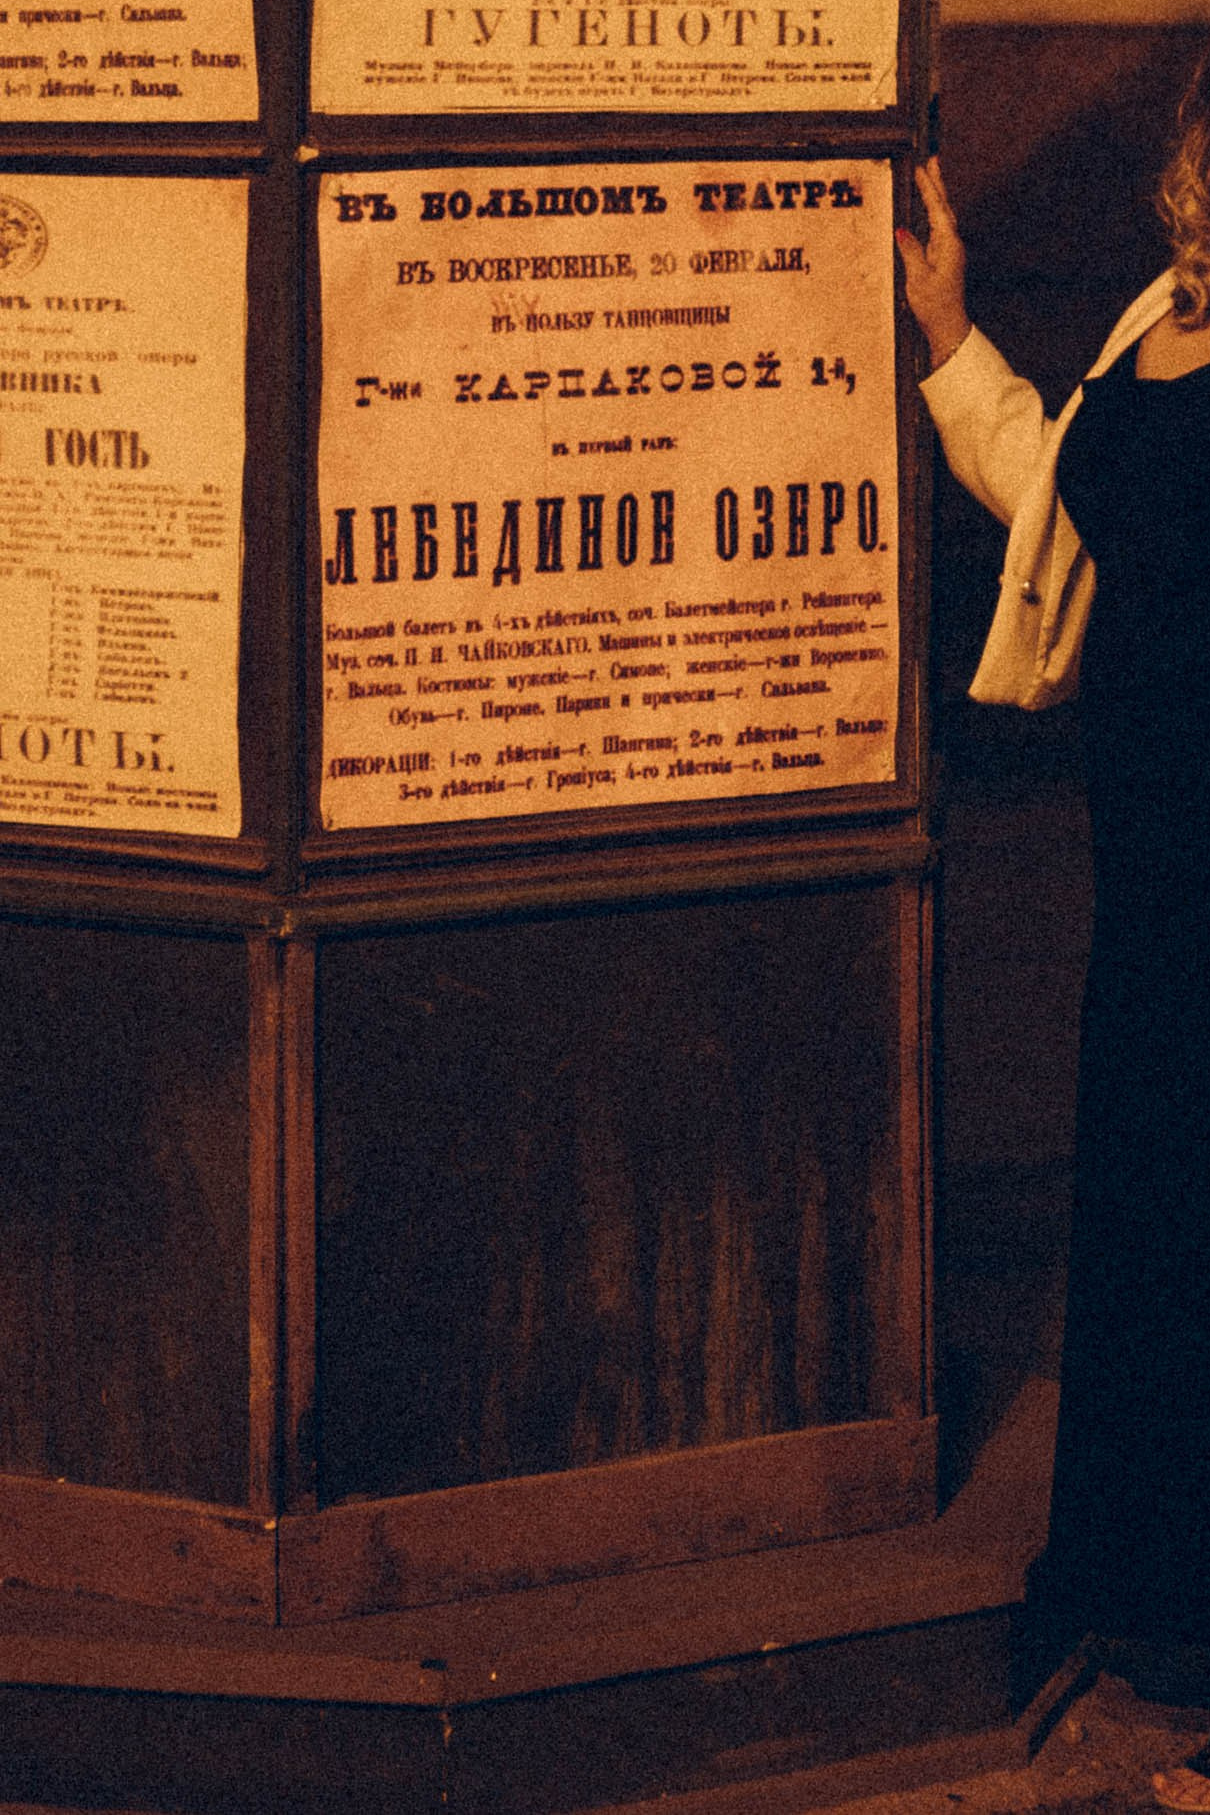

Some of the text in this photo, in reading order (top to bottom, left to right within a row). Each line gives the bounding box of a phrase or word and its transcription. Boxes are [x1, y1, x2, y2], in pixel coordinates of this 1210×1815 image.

[423, 8, 833, 48] ГУГЕНОТЫ.
[336, 193, 397, 222] ВЪ
[420, 185, 667, 221] БОЛЬШОМЪ
[397, 247, 811, 286] ВЪ ВОСКРЕСЕНЬЕ, 20 ФЕВРАЛЯ,
[455, 351, 782, 404] КАРПАКОВОЙ
[325, 489, 675, 587] ЛЕБЕДИНОЕ
[714, 479, 888, 562] ОЗЕРО.
[458, 636, 592, 662] ЧАЙКОВСКАГО.
